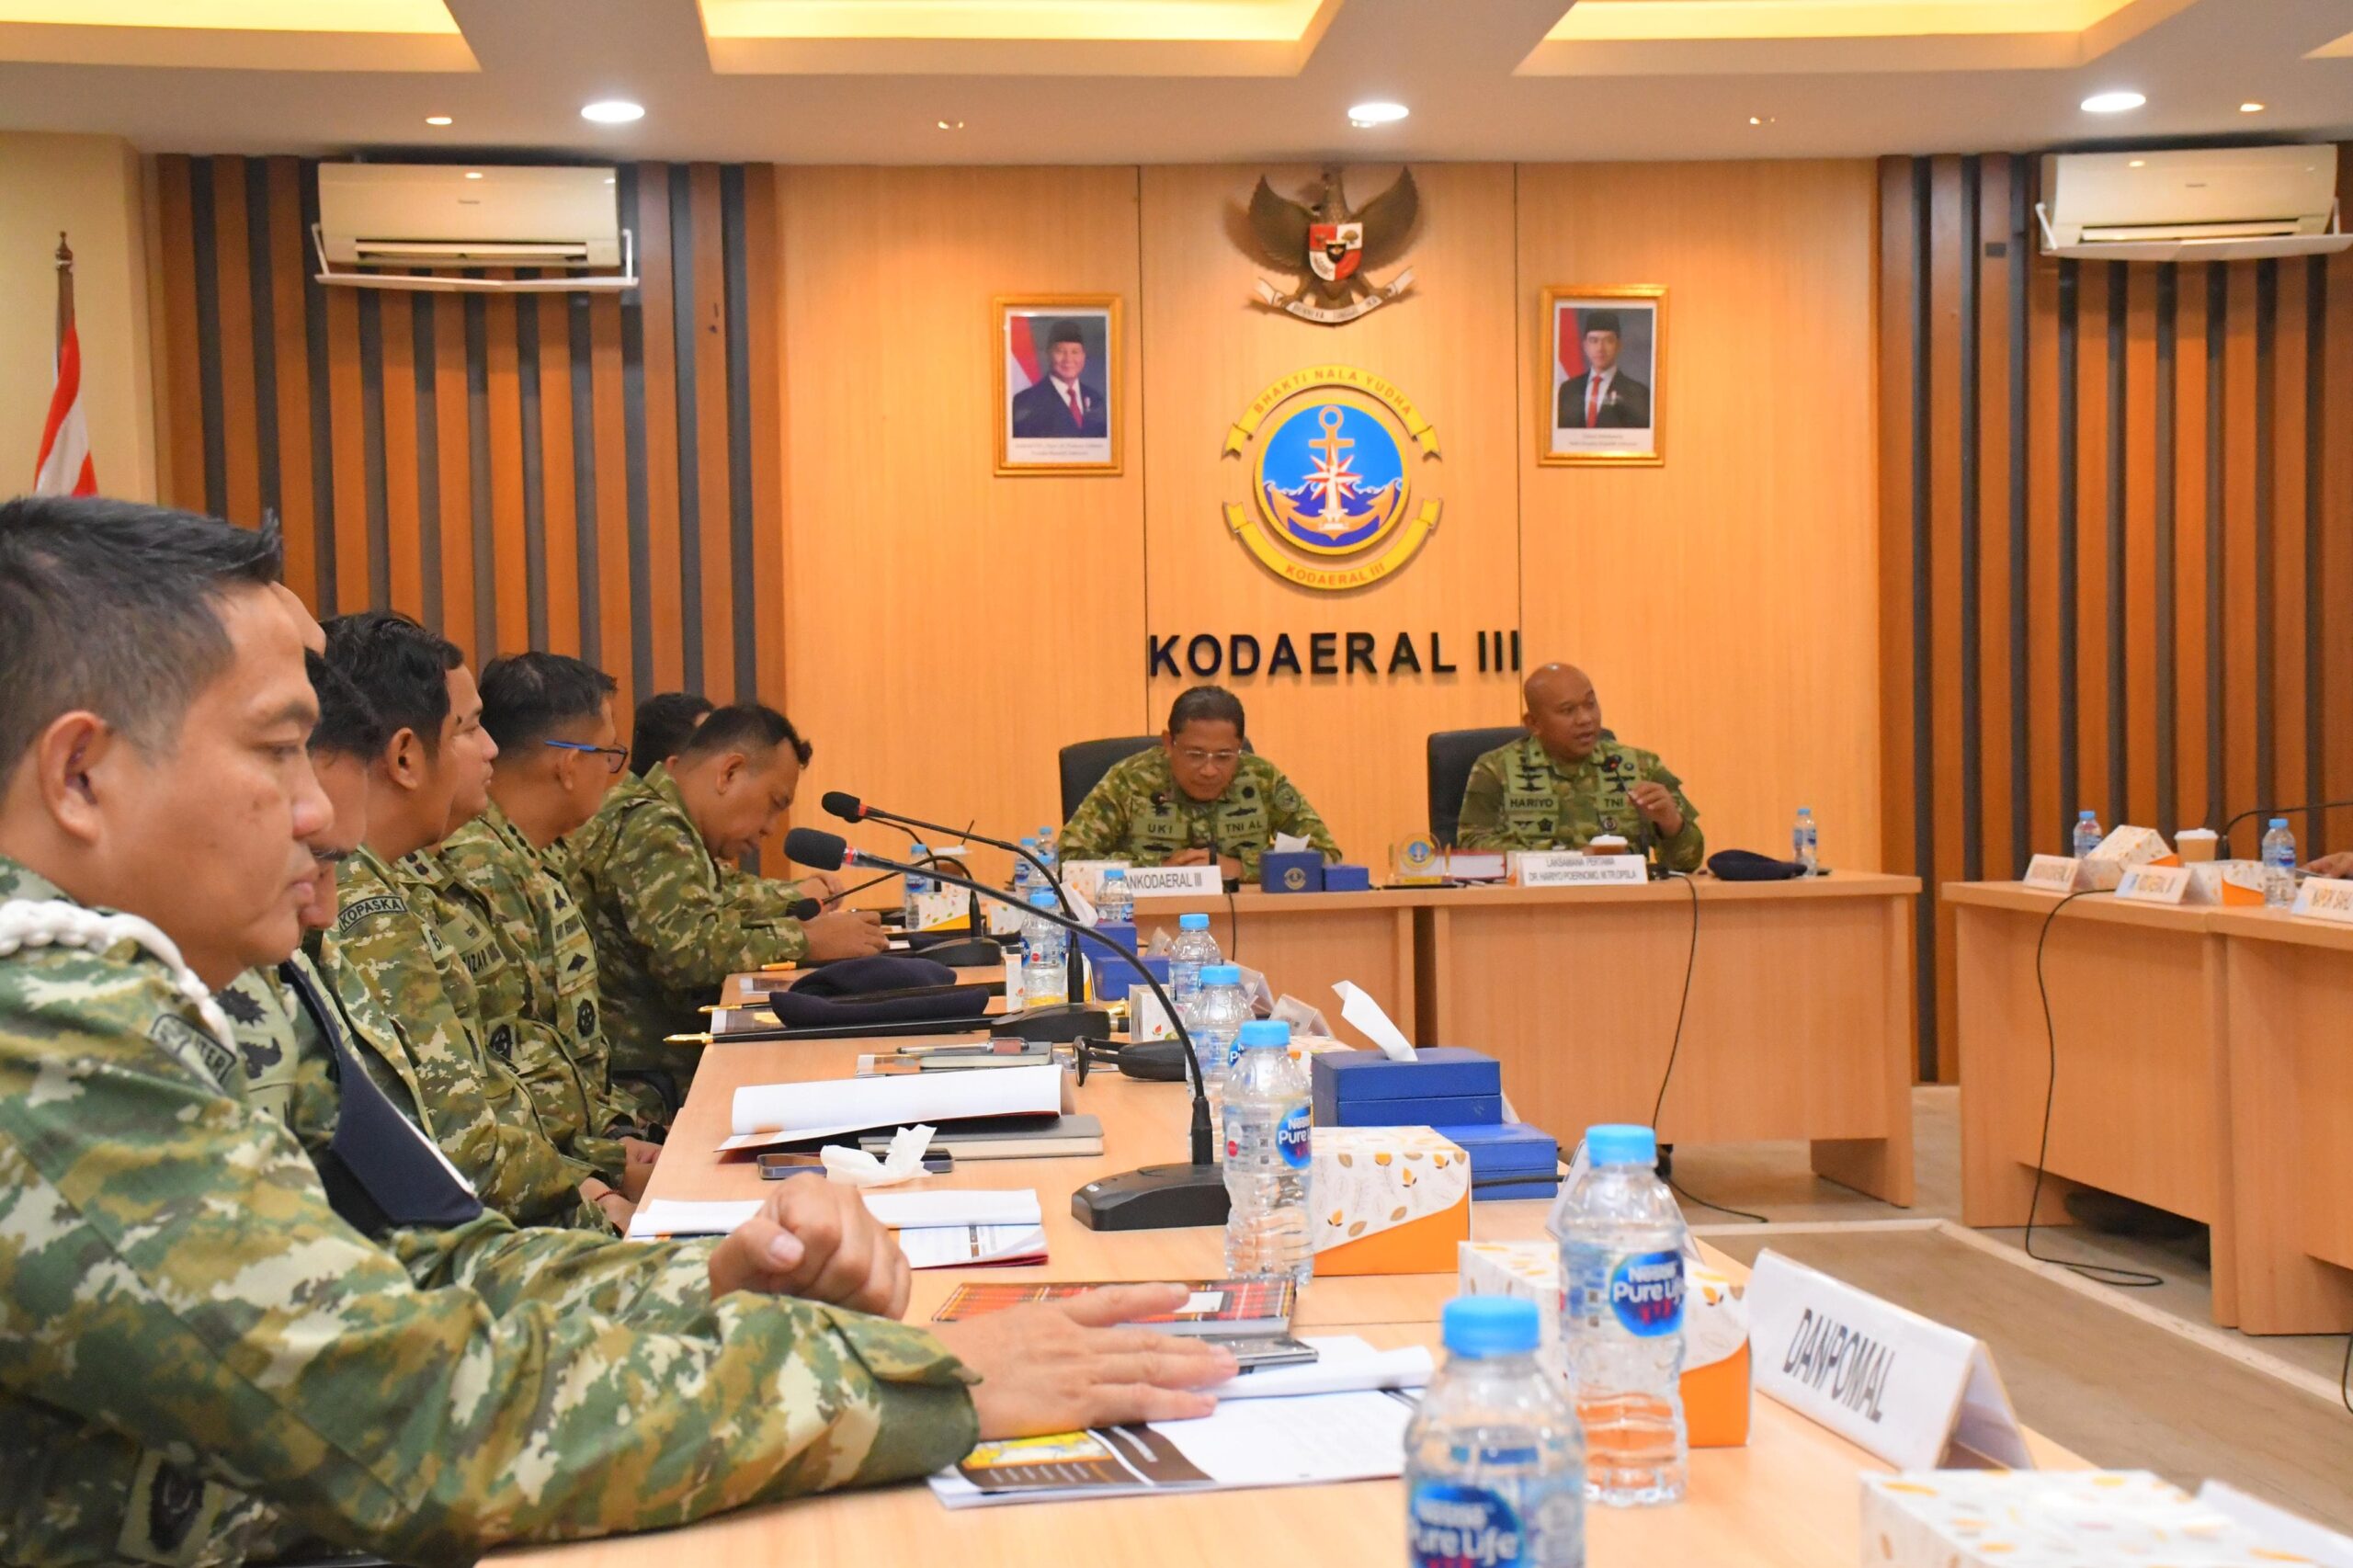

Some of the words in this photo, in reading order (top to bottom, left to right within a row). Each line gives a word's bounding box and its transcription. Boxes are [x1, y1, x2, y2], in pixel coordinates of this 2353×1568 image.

[1253, 373, 1308, 414] BHAKTI
[1313, 369, 1358, 381] NALA
[1366, 375, 1412, 415] YUDHA
[1286, 564, 1367, 585] KODAERAL
[1370, 562, 1385, 576] III
[1149, 631, 1458, 676] KODAERAL
[1477, 630, 1519, 673] III
[1509, 797, 1553, 808] HARIYO
[1604, 798, 1624, 807] TNI
[1225, 823, 1245, 833] TNI
[339, 899, 402, 930] KOPASKA
[1279, 1130, 1307, 1145] Pure
[1613, 1280, 1663, 1303] Pure
